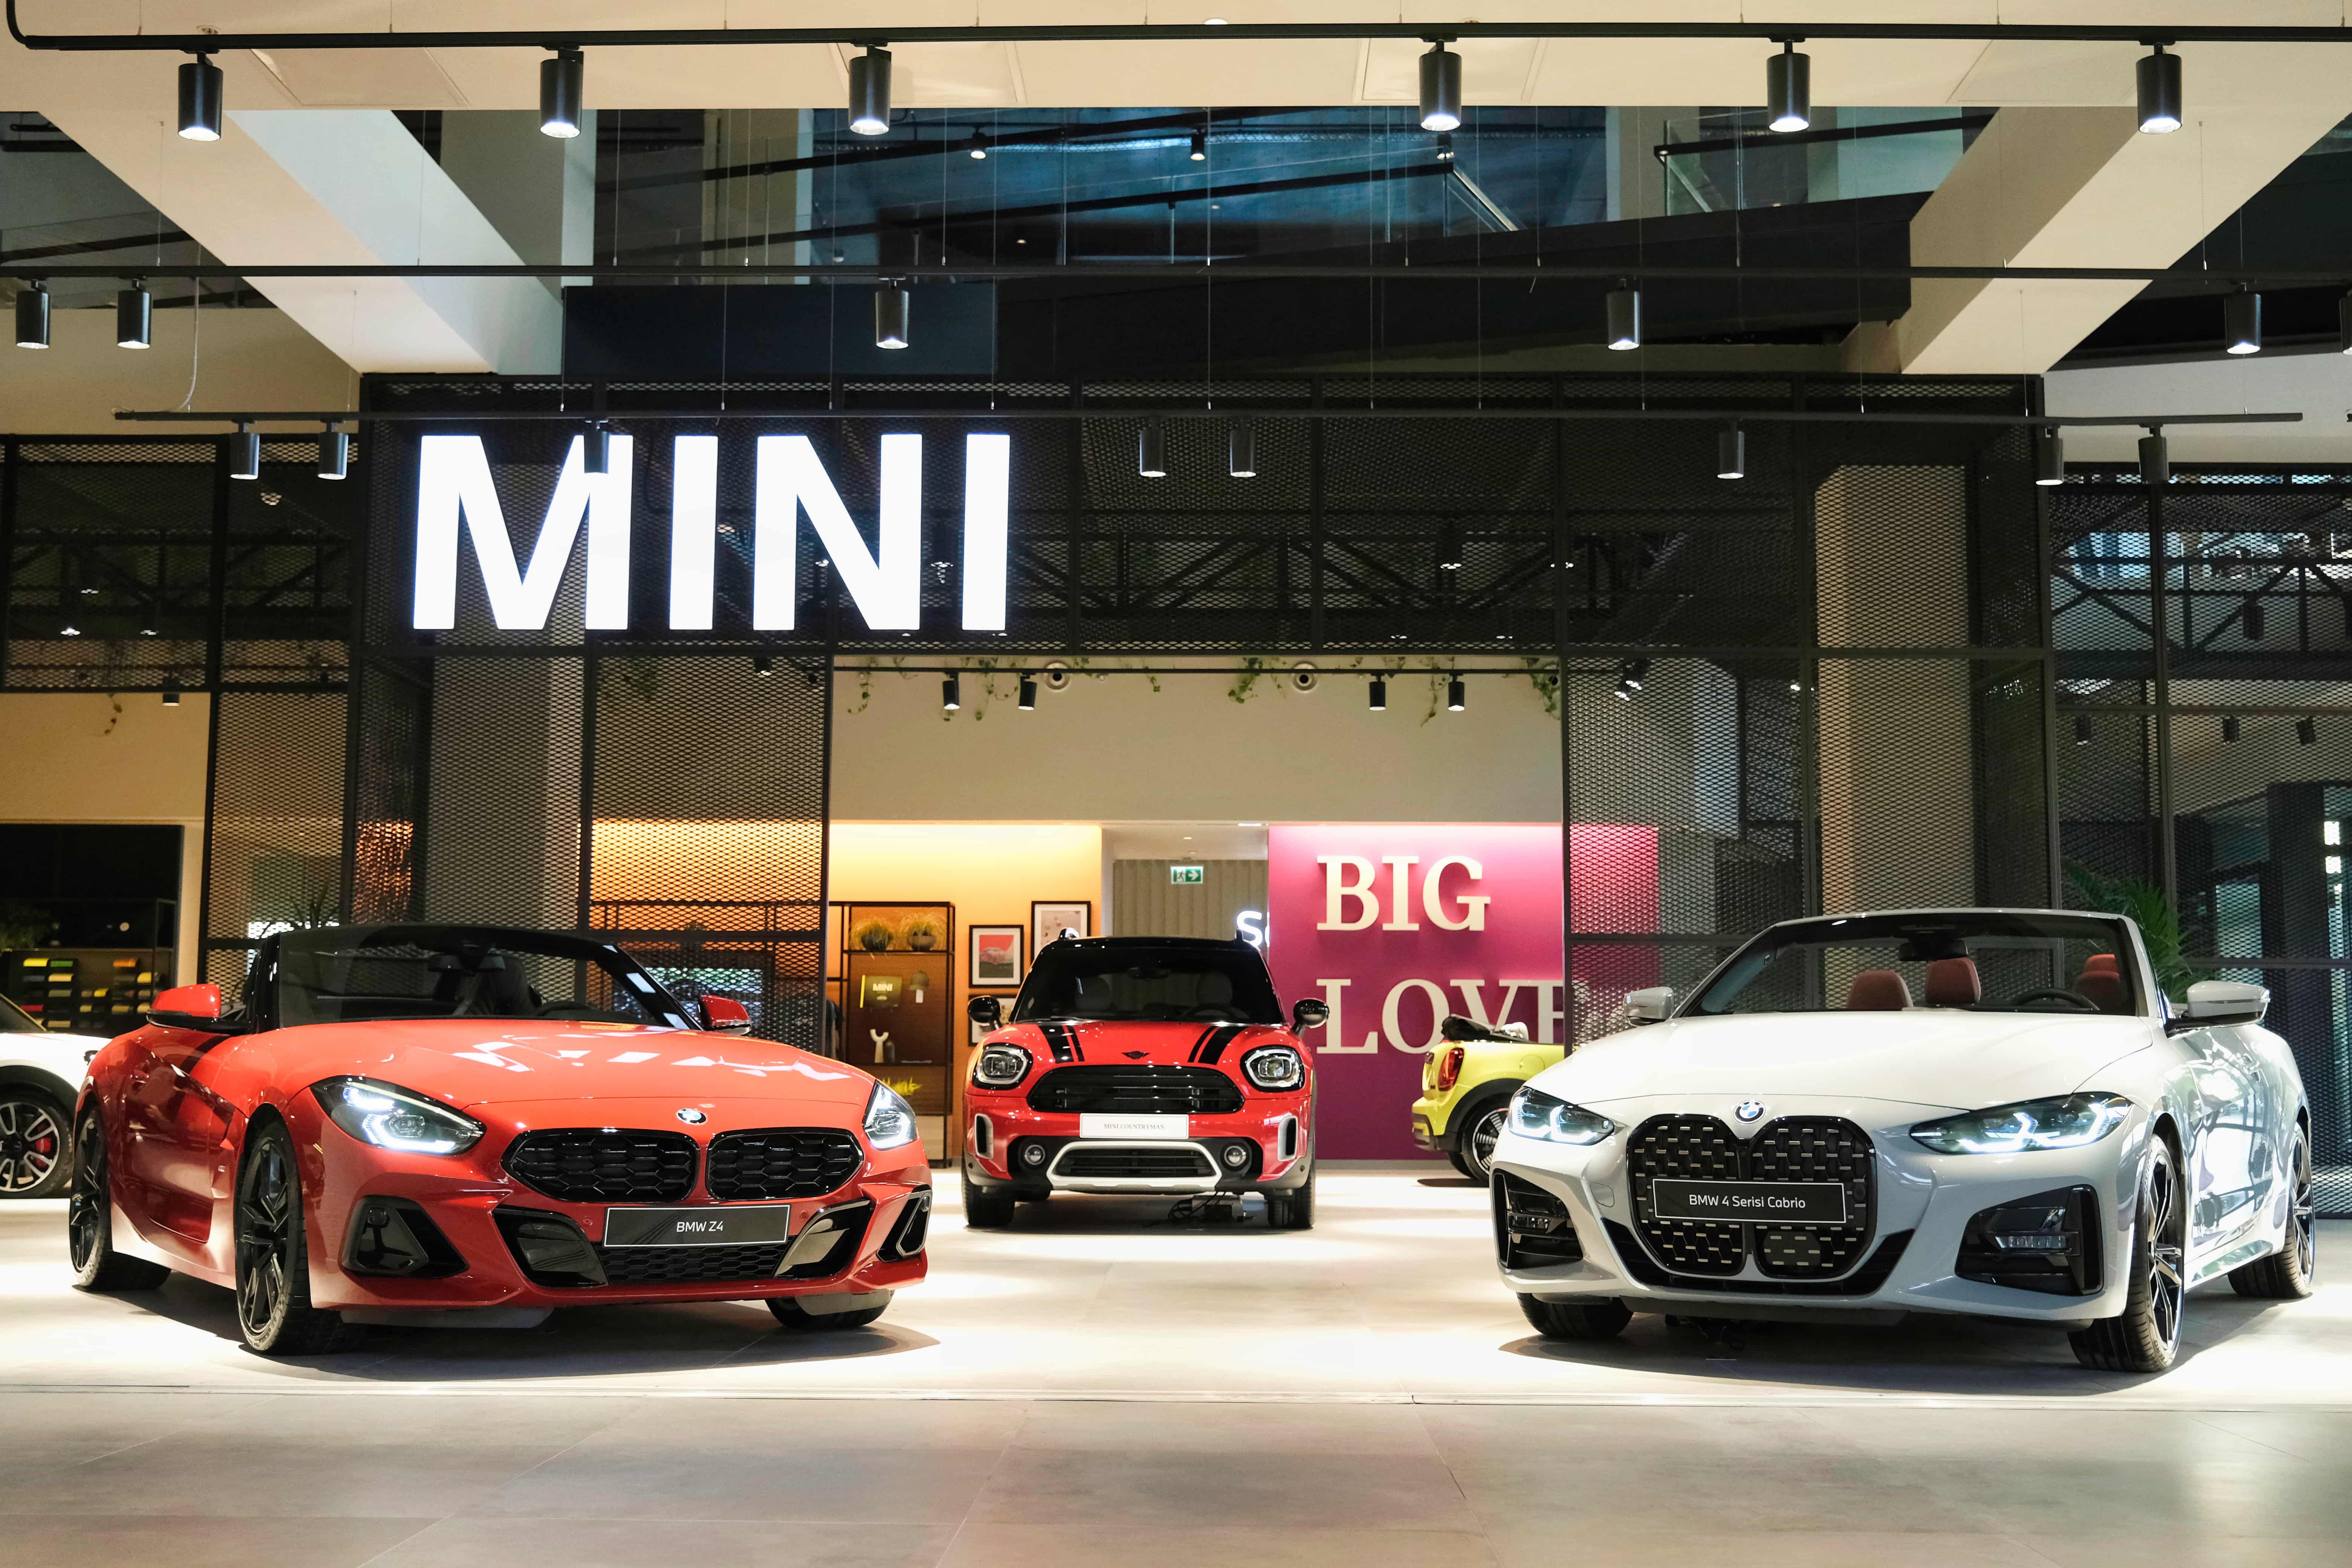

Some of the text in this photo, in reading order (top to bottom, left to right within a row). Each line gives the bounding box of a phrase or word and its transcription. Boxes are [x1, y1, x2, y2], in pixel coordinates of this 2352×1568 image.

[413, 435, 1010, 630] MINI
[1317, 856, 1490, 931] BIG
[1689, 1194, 1805, 1208] BMW 4 Serisi Cabrio
[676, 1221, 723, 1232] BMW Z4
